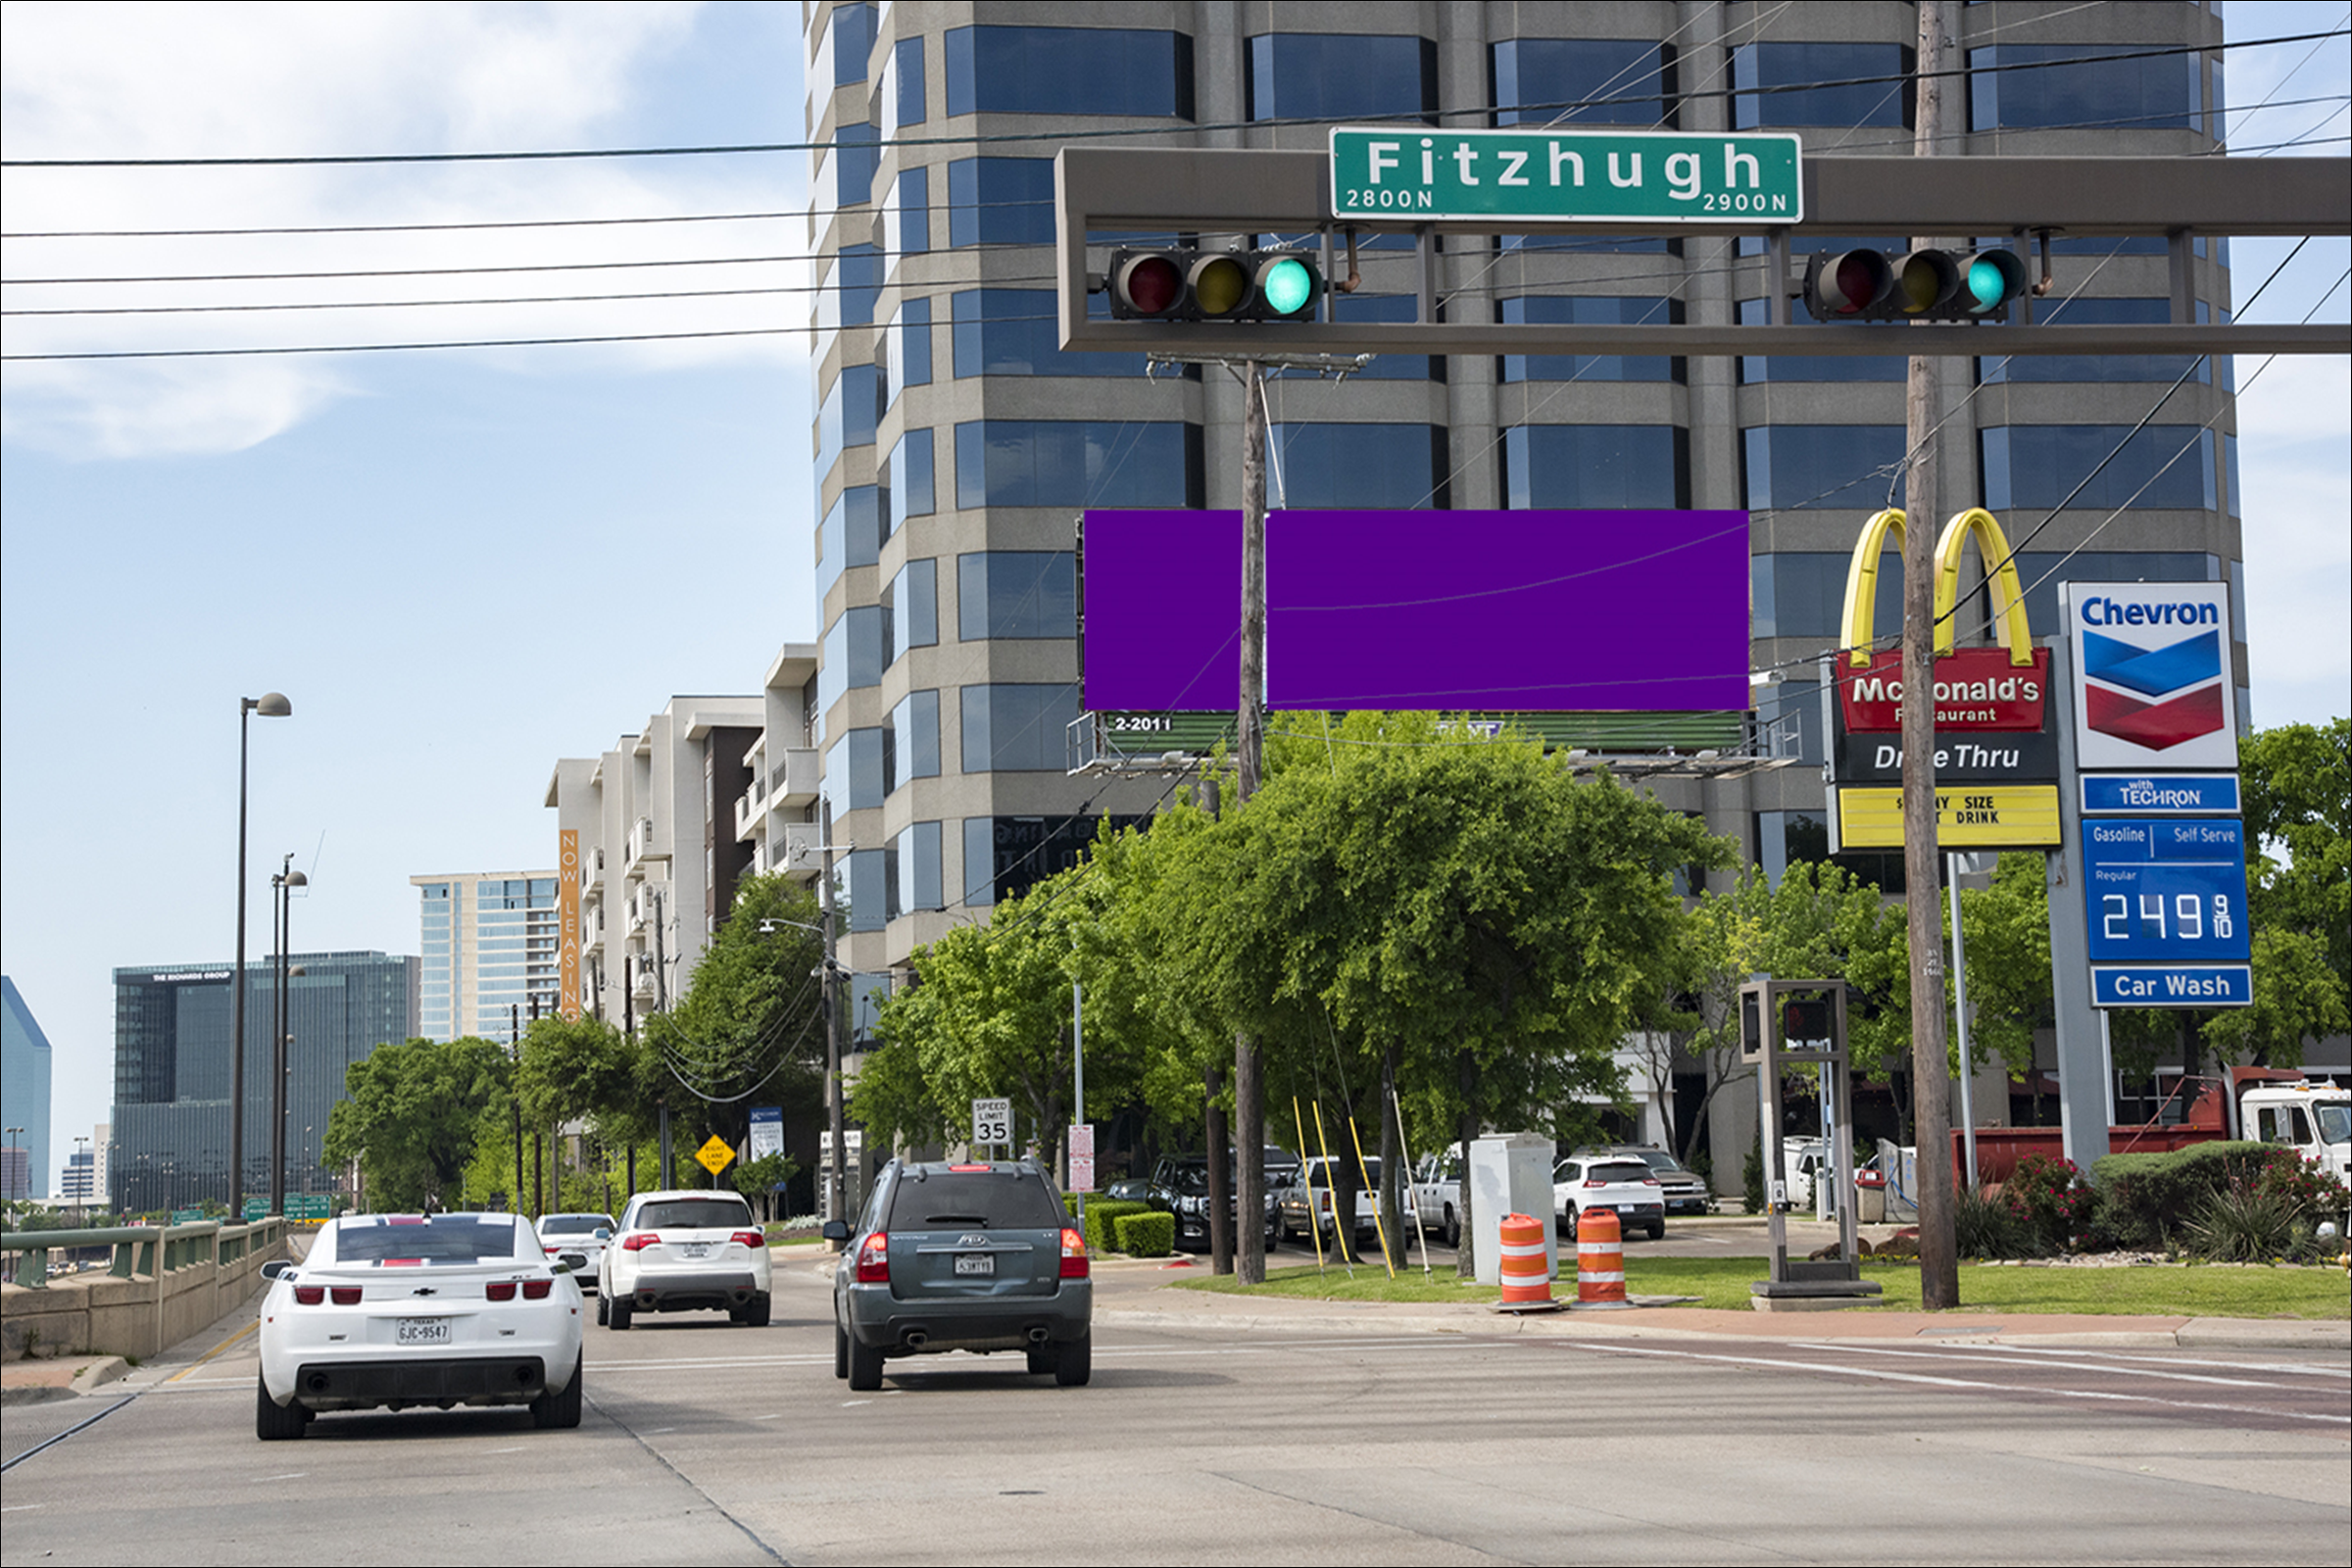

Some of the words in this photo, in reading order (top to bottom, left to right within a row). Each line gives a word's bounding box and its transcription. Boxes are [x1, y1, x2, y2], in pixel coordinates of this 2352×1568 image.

[1367, 137, 1761, 201] Fitzhugh
[1347, 189, 1434, 209] 2800N
[1702, 193, 1788, 212] 2900N
[2081, 596, 2220, 626] Chevron
[1852, 676, 2040, 703] Mconald's
[1115, 716, 1171, 731] 2-2011
[1875, 745, 1950, 768] Dre
[1954, 744, 2020, 767] Thru
[2129, 779, 2154, 790] with
[1964, 796, 1994, 809] SIZE
[2120, 787, 2202, 808] TECHRON
[1956, 810, 1999, 824] DRINK
[2093, 826, 2145, 843] Gasoline
[2174, 826, 2198, 843] Self
[2200, 827, 2236, 843] Serve
[563, 835, 578, 882] NOW
[2095, 870, 2137, 882] Regular
[563, 902, 578, 1022] LEASING
[2115, 975, 2158, 997] Car
[2165, 974, 2231, 997] Wash
[975, 1102, 1007, 1111] SPEED
[978, 1111, 1004, 1121] LIMIT
[978, 1122, 1007, 1141] 35
[399, 1325, 448, 1340] GJC-9547
